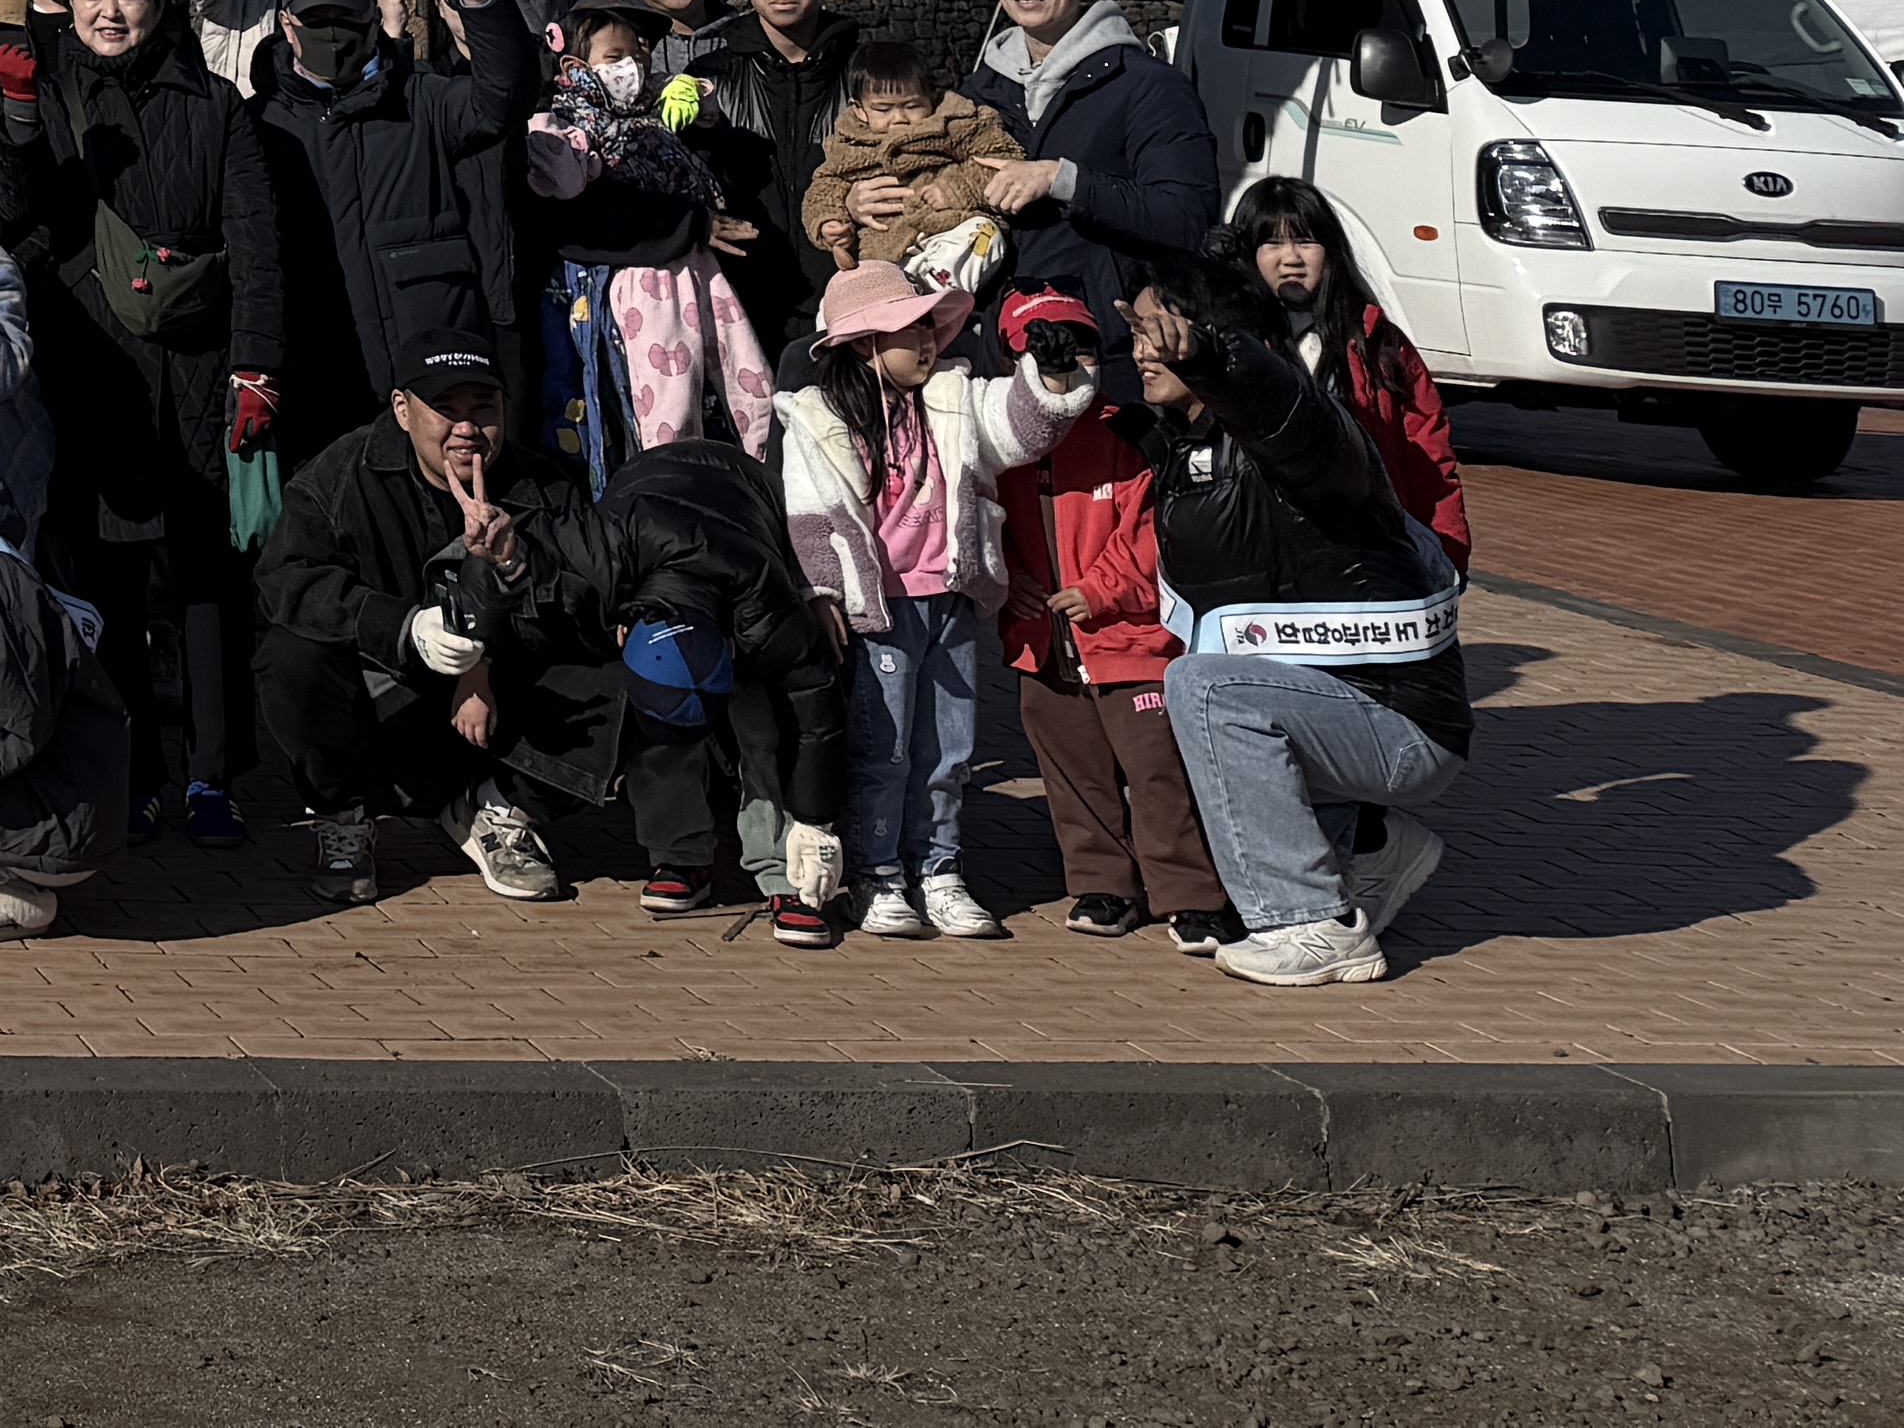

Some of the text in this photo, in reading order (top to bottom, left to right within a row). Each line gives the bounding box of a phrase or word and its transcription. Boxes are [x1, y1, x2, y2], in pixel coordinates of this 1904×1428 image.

[1752, 176, 1788, 192] KIA
[1733, 289, 1861, 320] 80무 5760
[1273, 604, 1459, 646] 자치도관광협회
